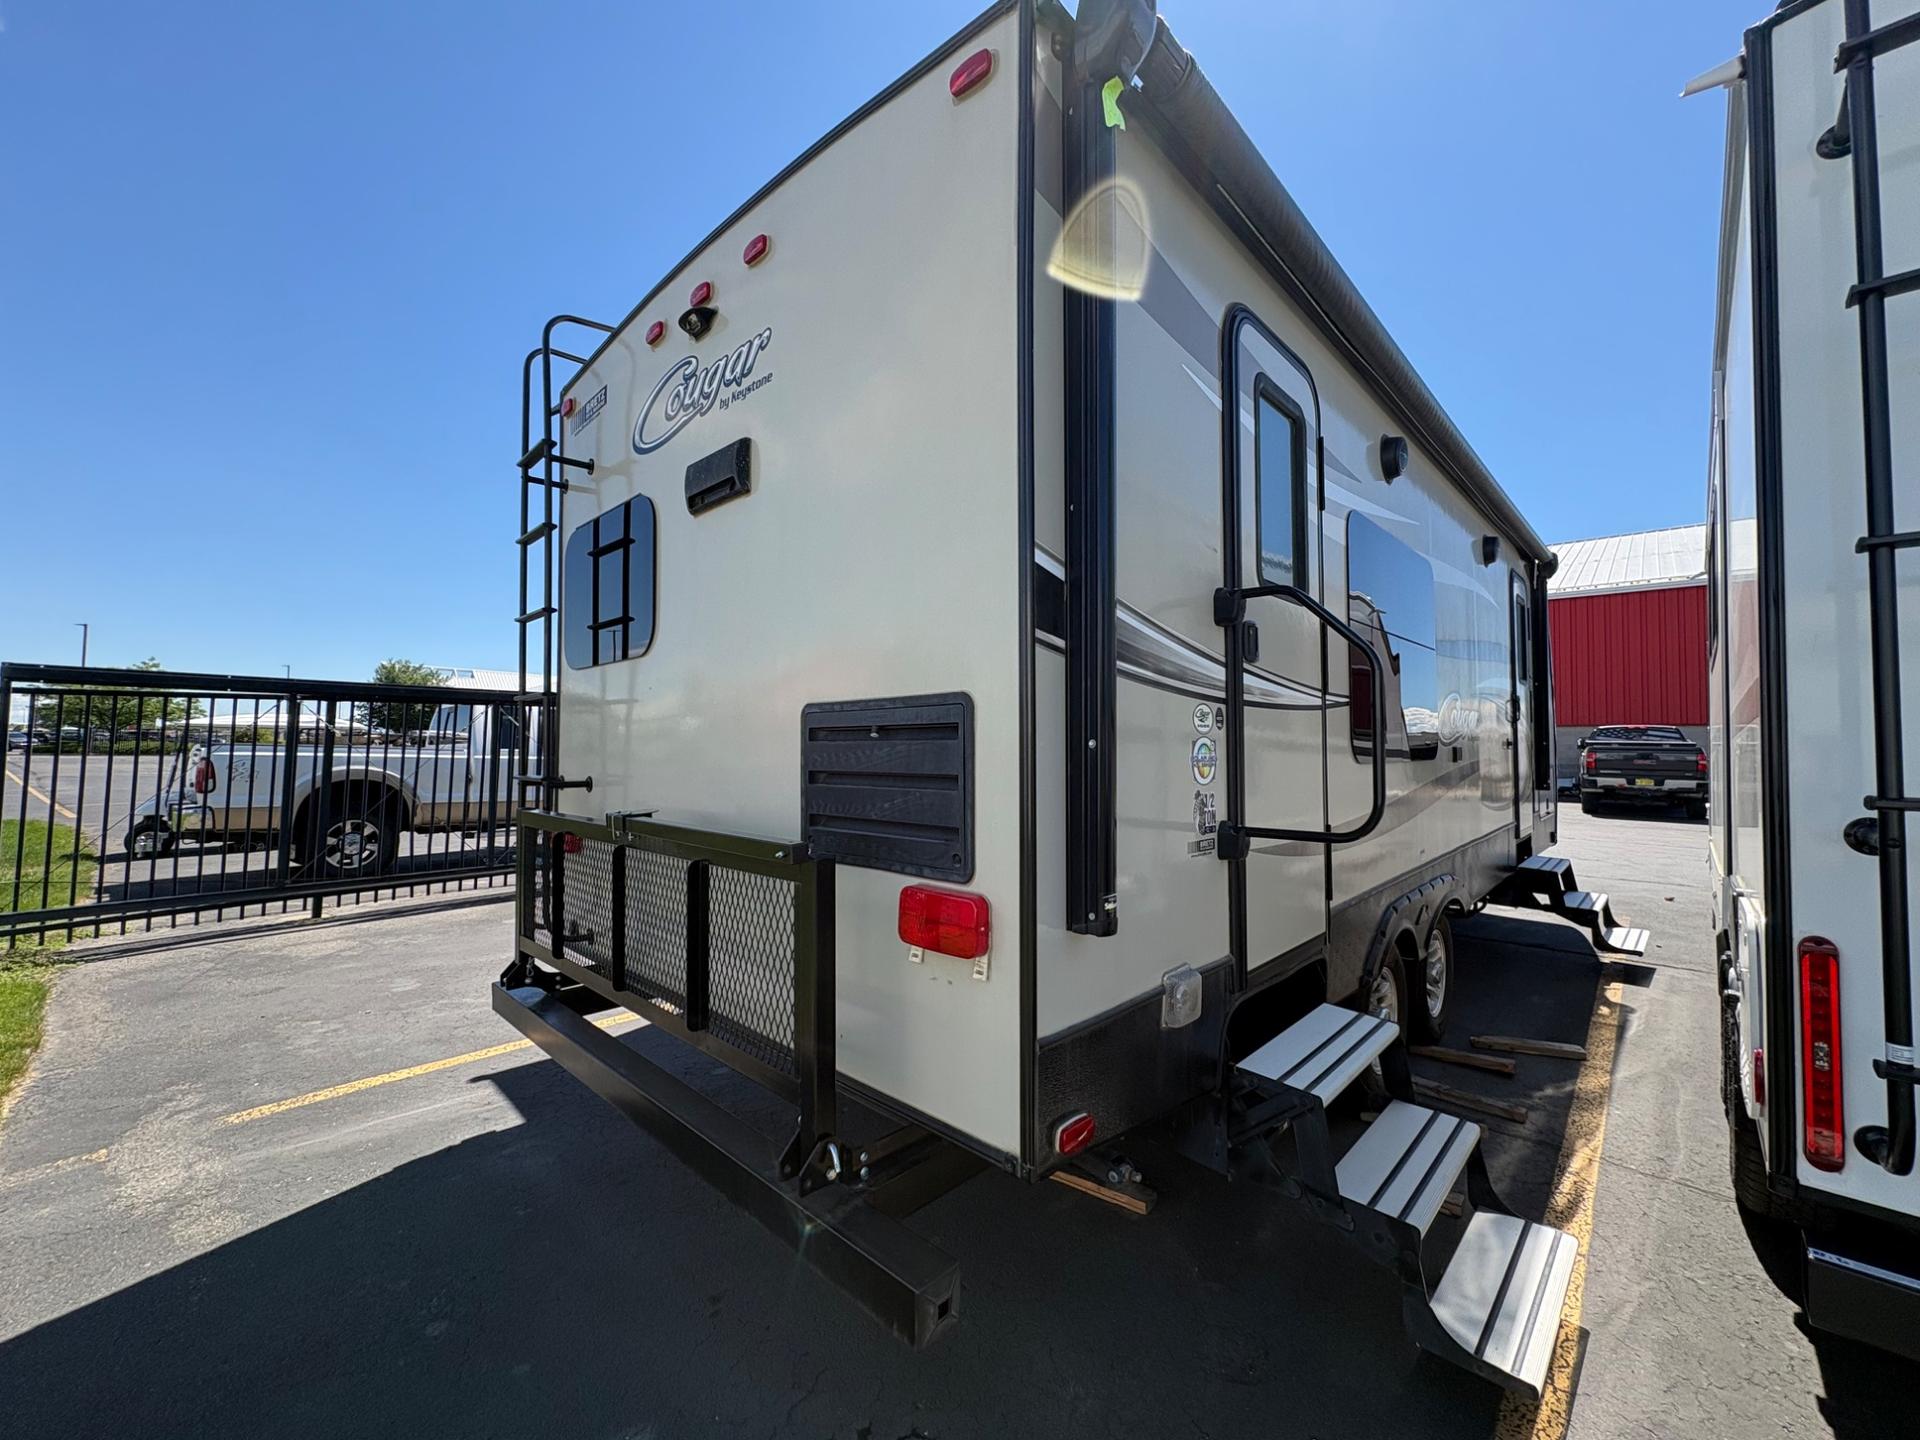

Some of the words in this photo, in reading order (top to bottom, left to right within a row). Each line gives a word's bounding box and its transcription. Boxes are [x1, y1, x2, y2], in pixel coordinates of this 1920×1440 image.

[633, 327, 772, 455] Cougar
[719, 396, 730, 410] by
[731, 372, 773, 405] Keystone
